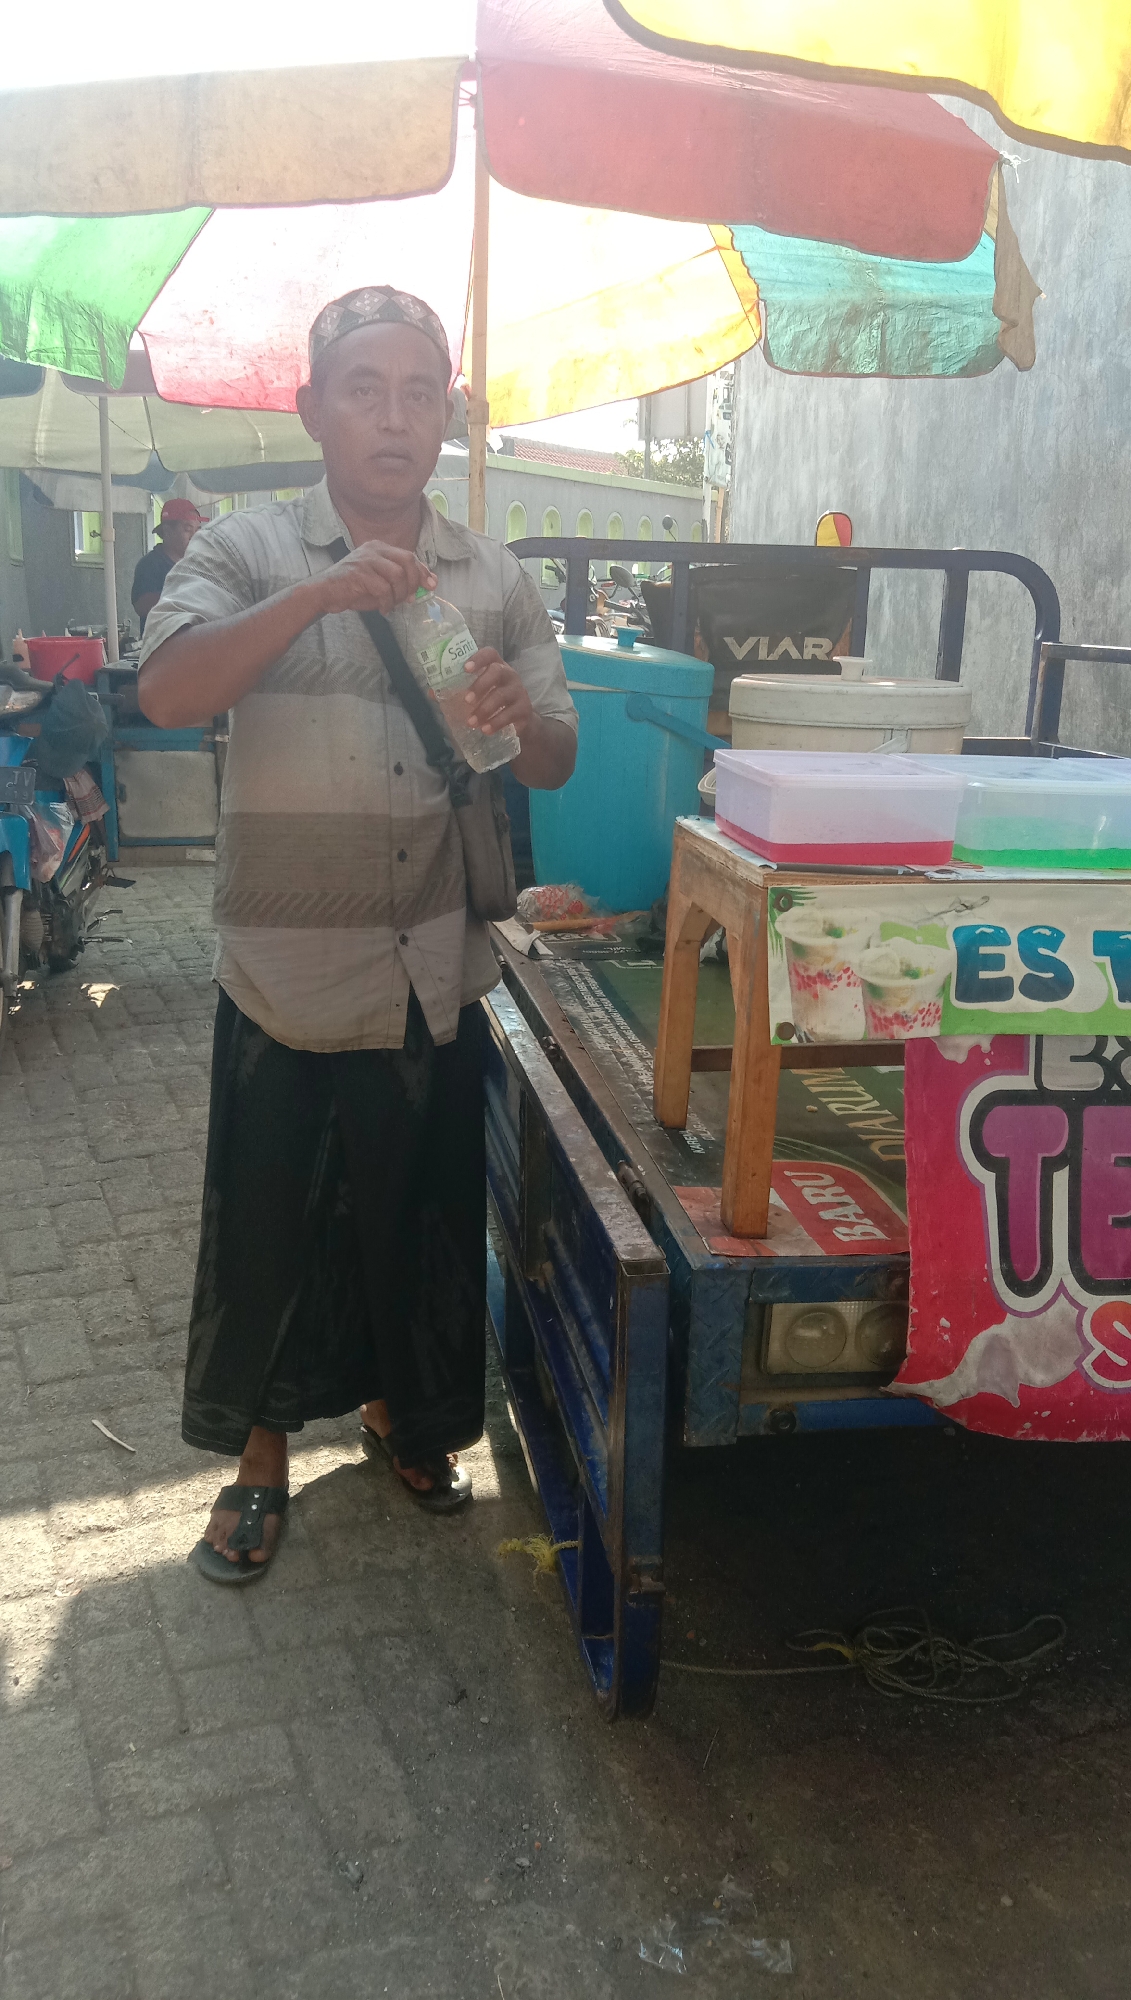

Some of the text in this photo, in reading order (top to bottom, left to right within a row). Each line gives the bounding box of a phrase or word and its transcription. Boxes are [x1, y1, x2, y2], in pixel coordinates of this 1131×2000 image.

[723, 636, 833, 661] VIAR
[952, 924, 1075, 1003] ES
[783, 1170, 892, 1243] BARU
